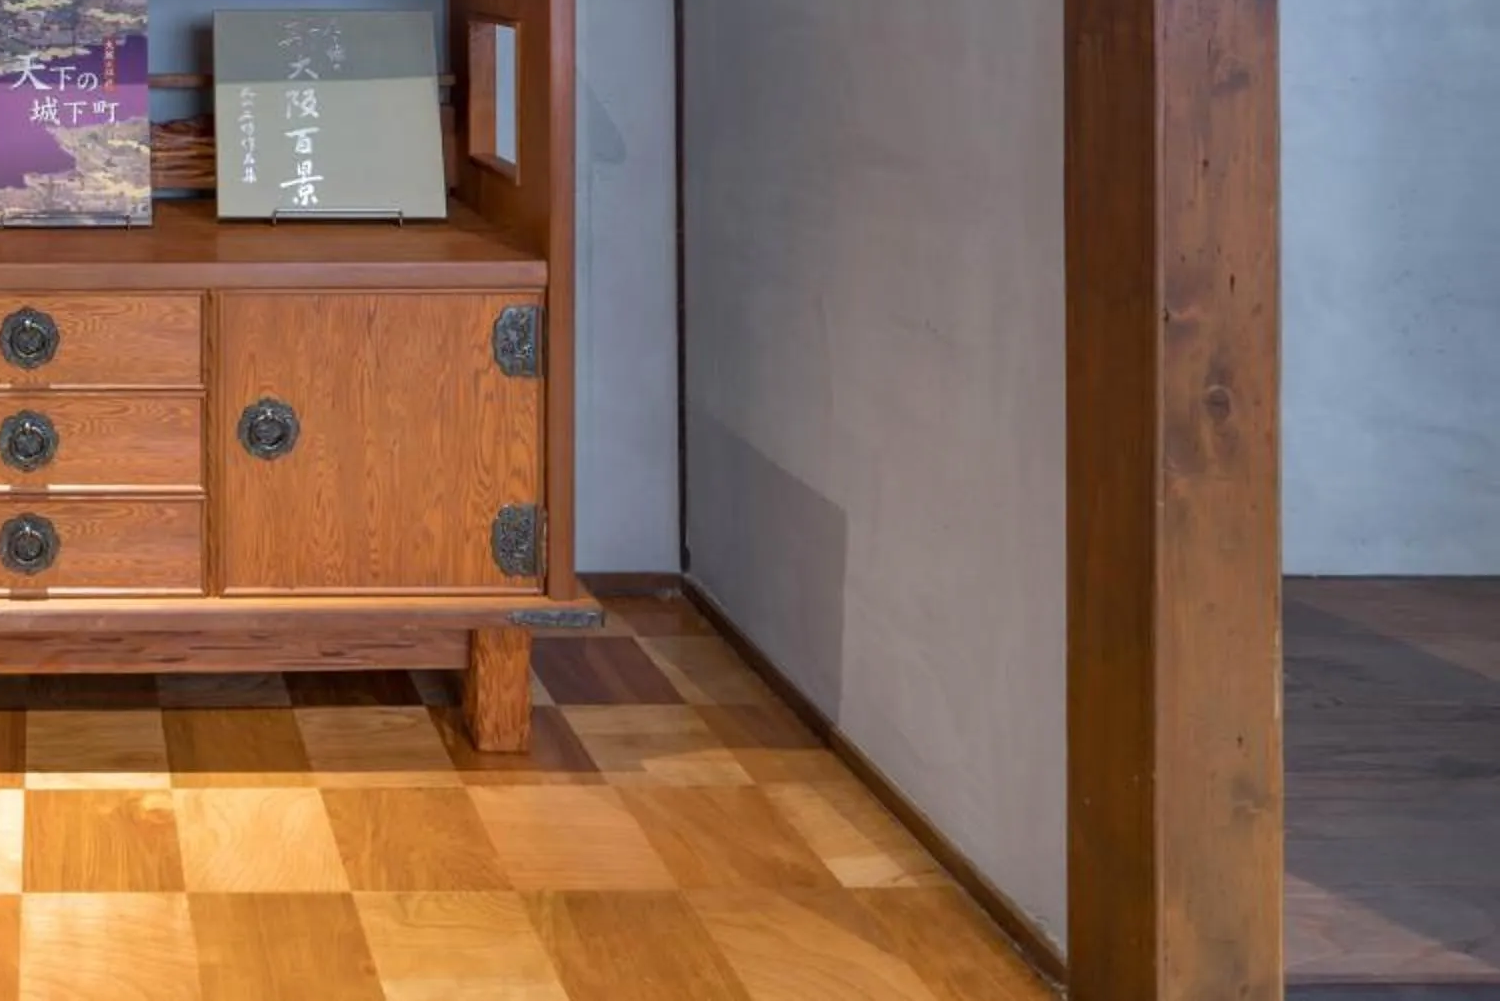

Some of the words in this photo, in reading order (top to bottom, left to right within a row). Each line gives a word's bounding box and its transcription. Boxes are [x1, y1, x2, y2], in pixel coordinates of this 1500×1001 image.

[9, 53, 100, 92] 天下の
[29, 96, 122, 125] 城下町
[279, 55, 324, 207] 大阪百景
